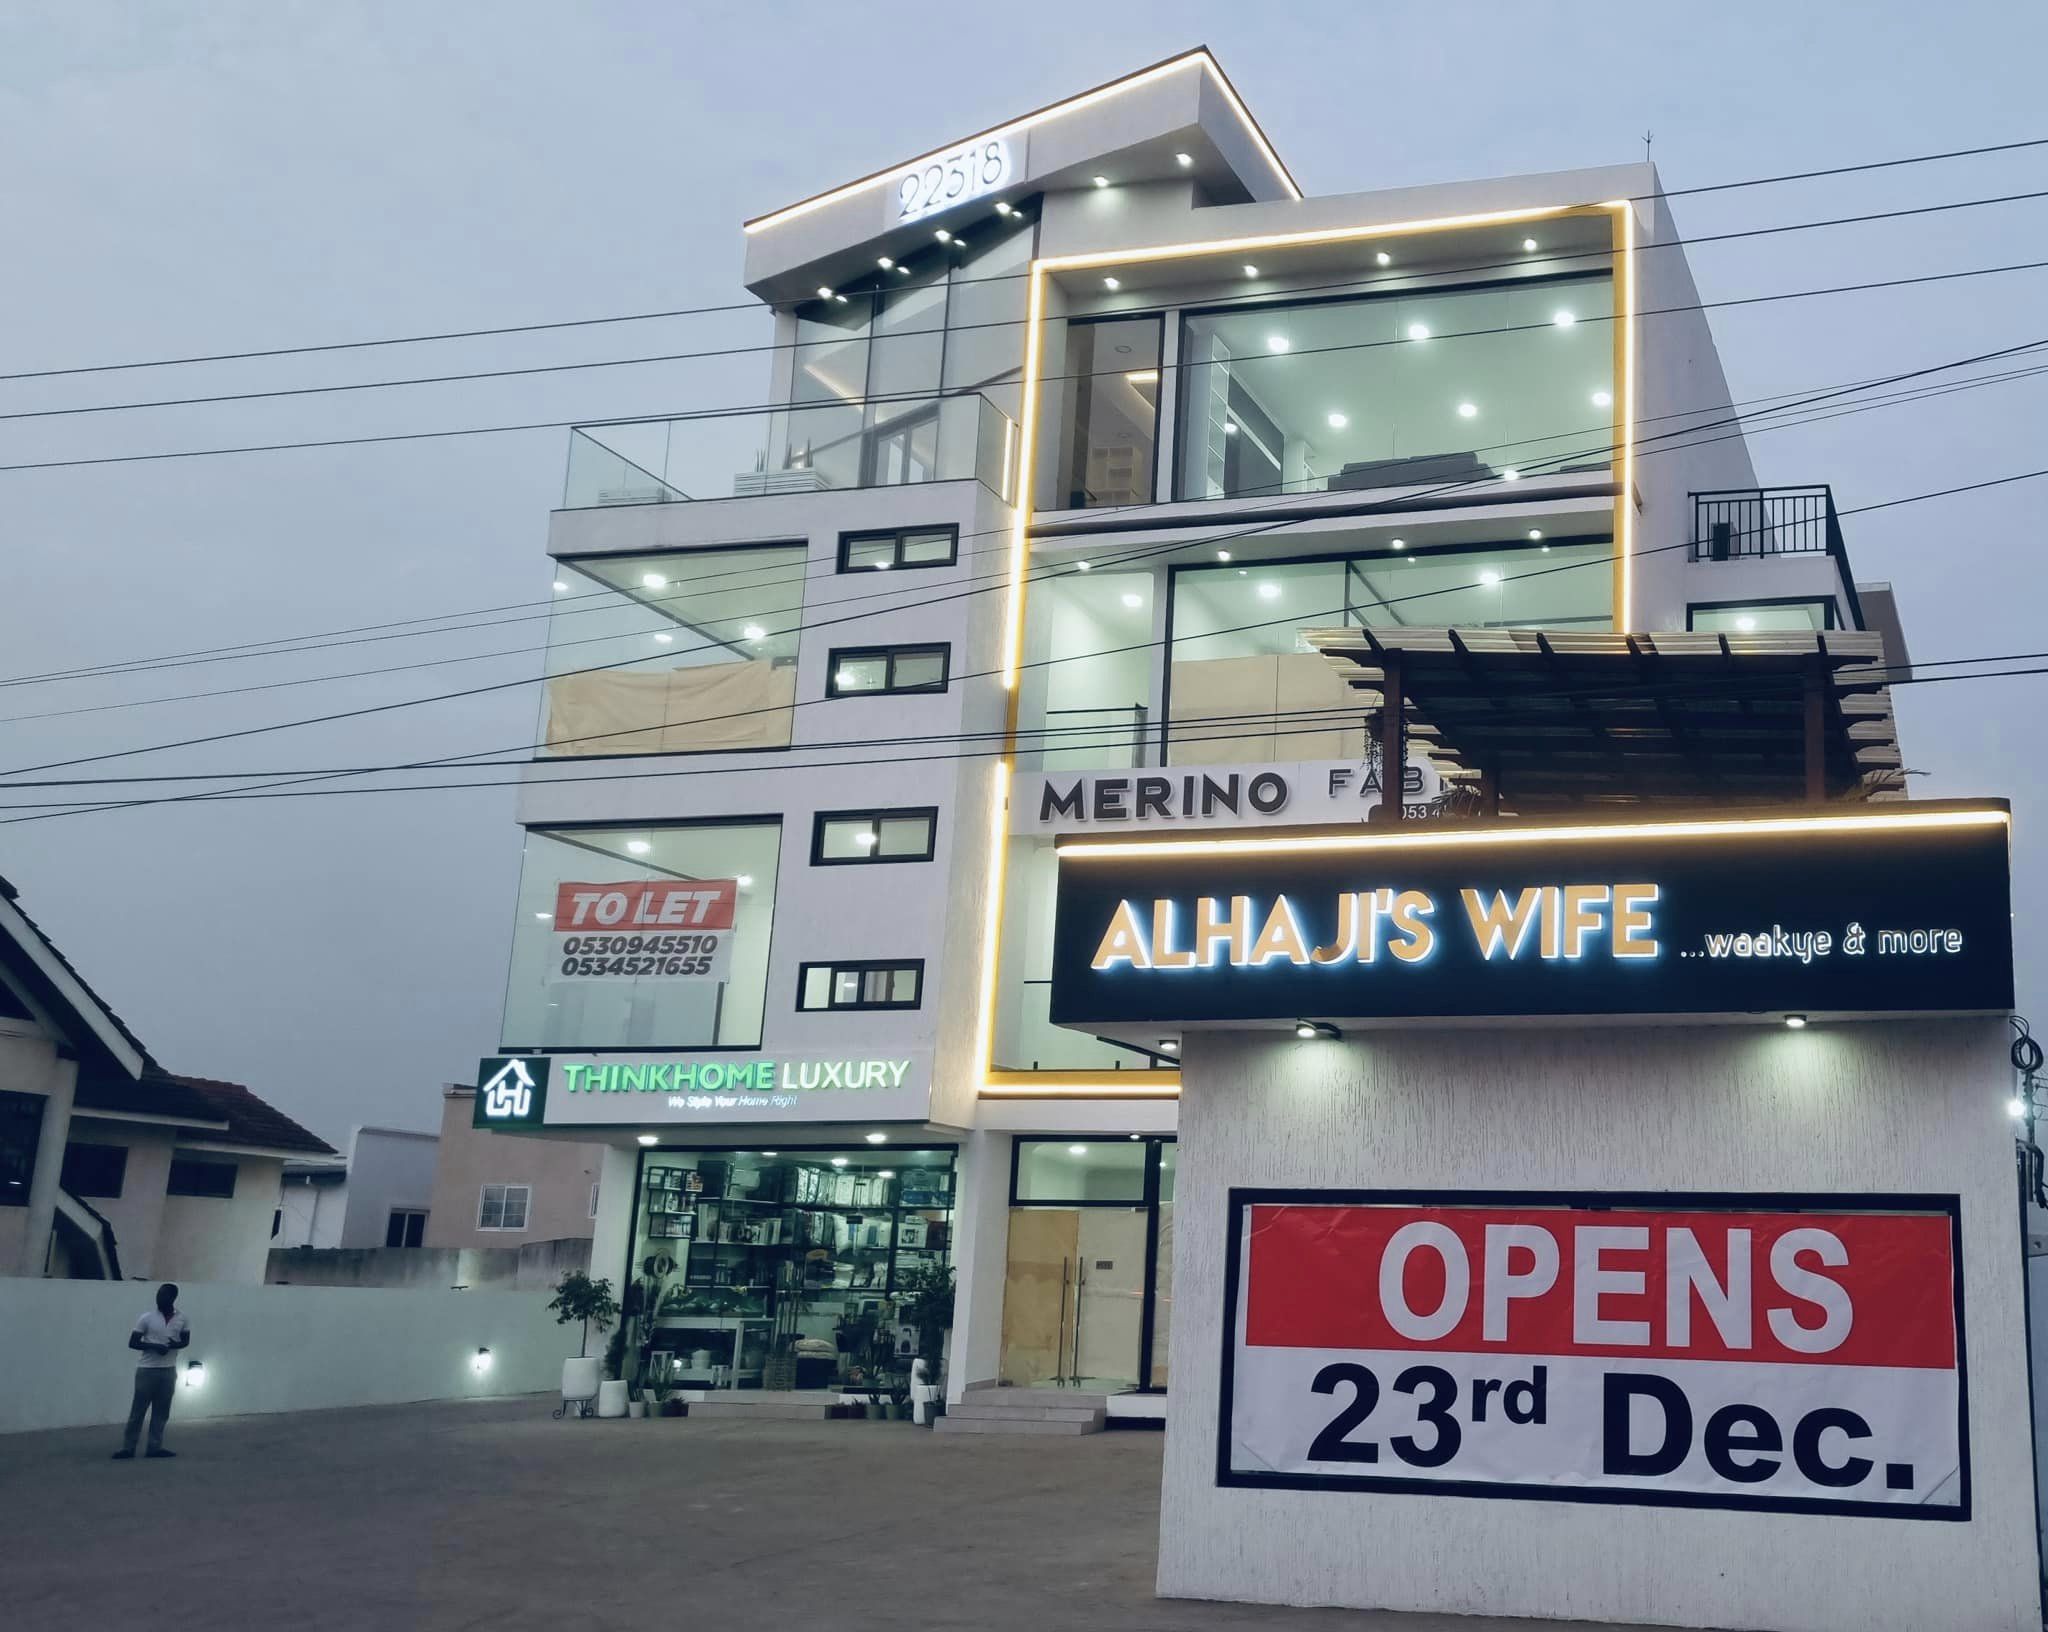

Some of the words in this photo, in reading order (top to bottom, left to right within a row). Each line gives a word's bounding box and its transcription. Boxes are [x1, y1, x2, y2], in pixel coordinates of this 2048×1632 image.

[1039, 772, 1289, 822] MERINO
[1329, 766, 1448, 798] FAB
[571, 892, 628, 925] TO
[632, 890, 721, 924] LET
[1091, 888, 1434, 969] ALHAJI'S
[1460, 884, 1659, 960] WIFE
[1843, 922, 1866, 955] &
[1878, 928, 1963, 954] more
[563, 935, 718, 955] 0530945510
[561, 955, 713, 976] 0534521655
[564, 1062, 776, 1092] THINKHOME
[782, 1059, 912, 1090] LUXURY
[714, 1095, 738, 1108] Your
[738, 1095, 769, 1107] Home
[770, 1095, 798, 1108] Right
[1379, 1221, 1854, 1353] OPENS
[1306, 1363, 1548, 1468] 23rd
[1602, 1372, 1915, 1490] Dec.
